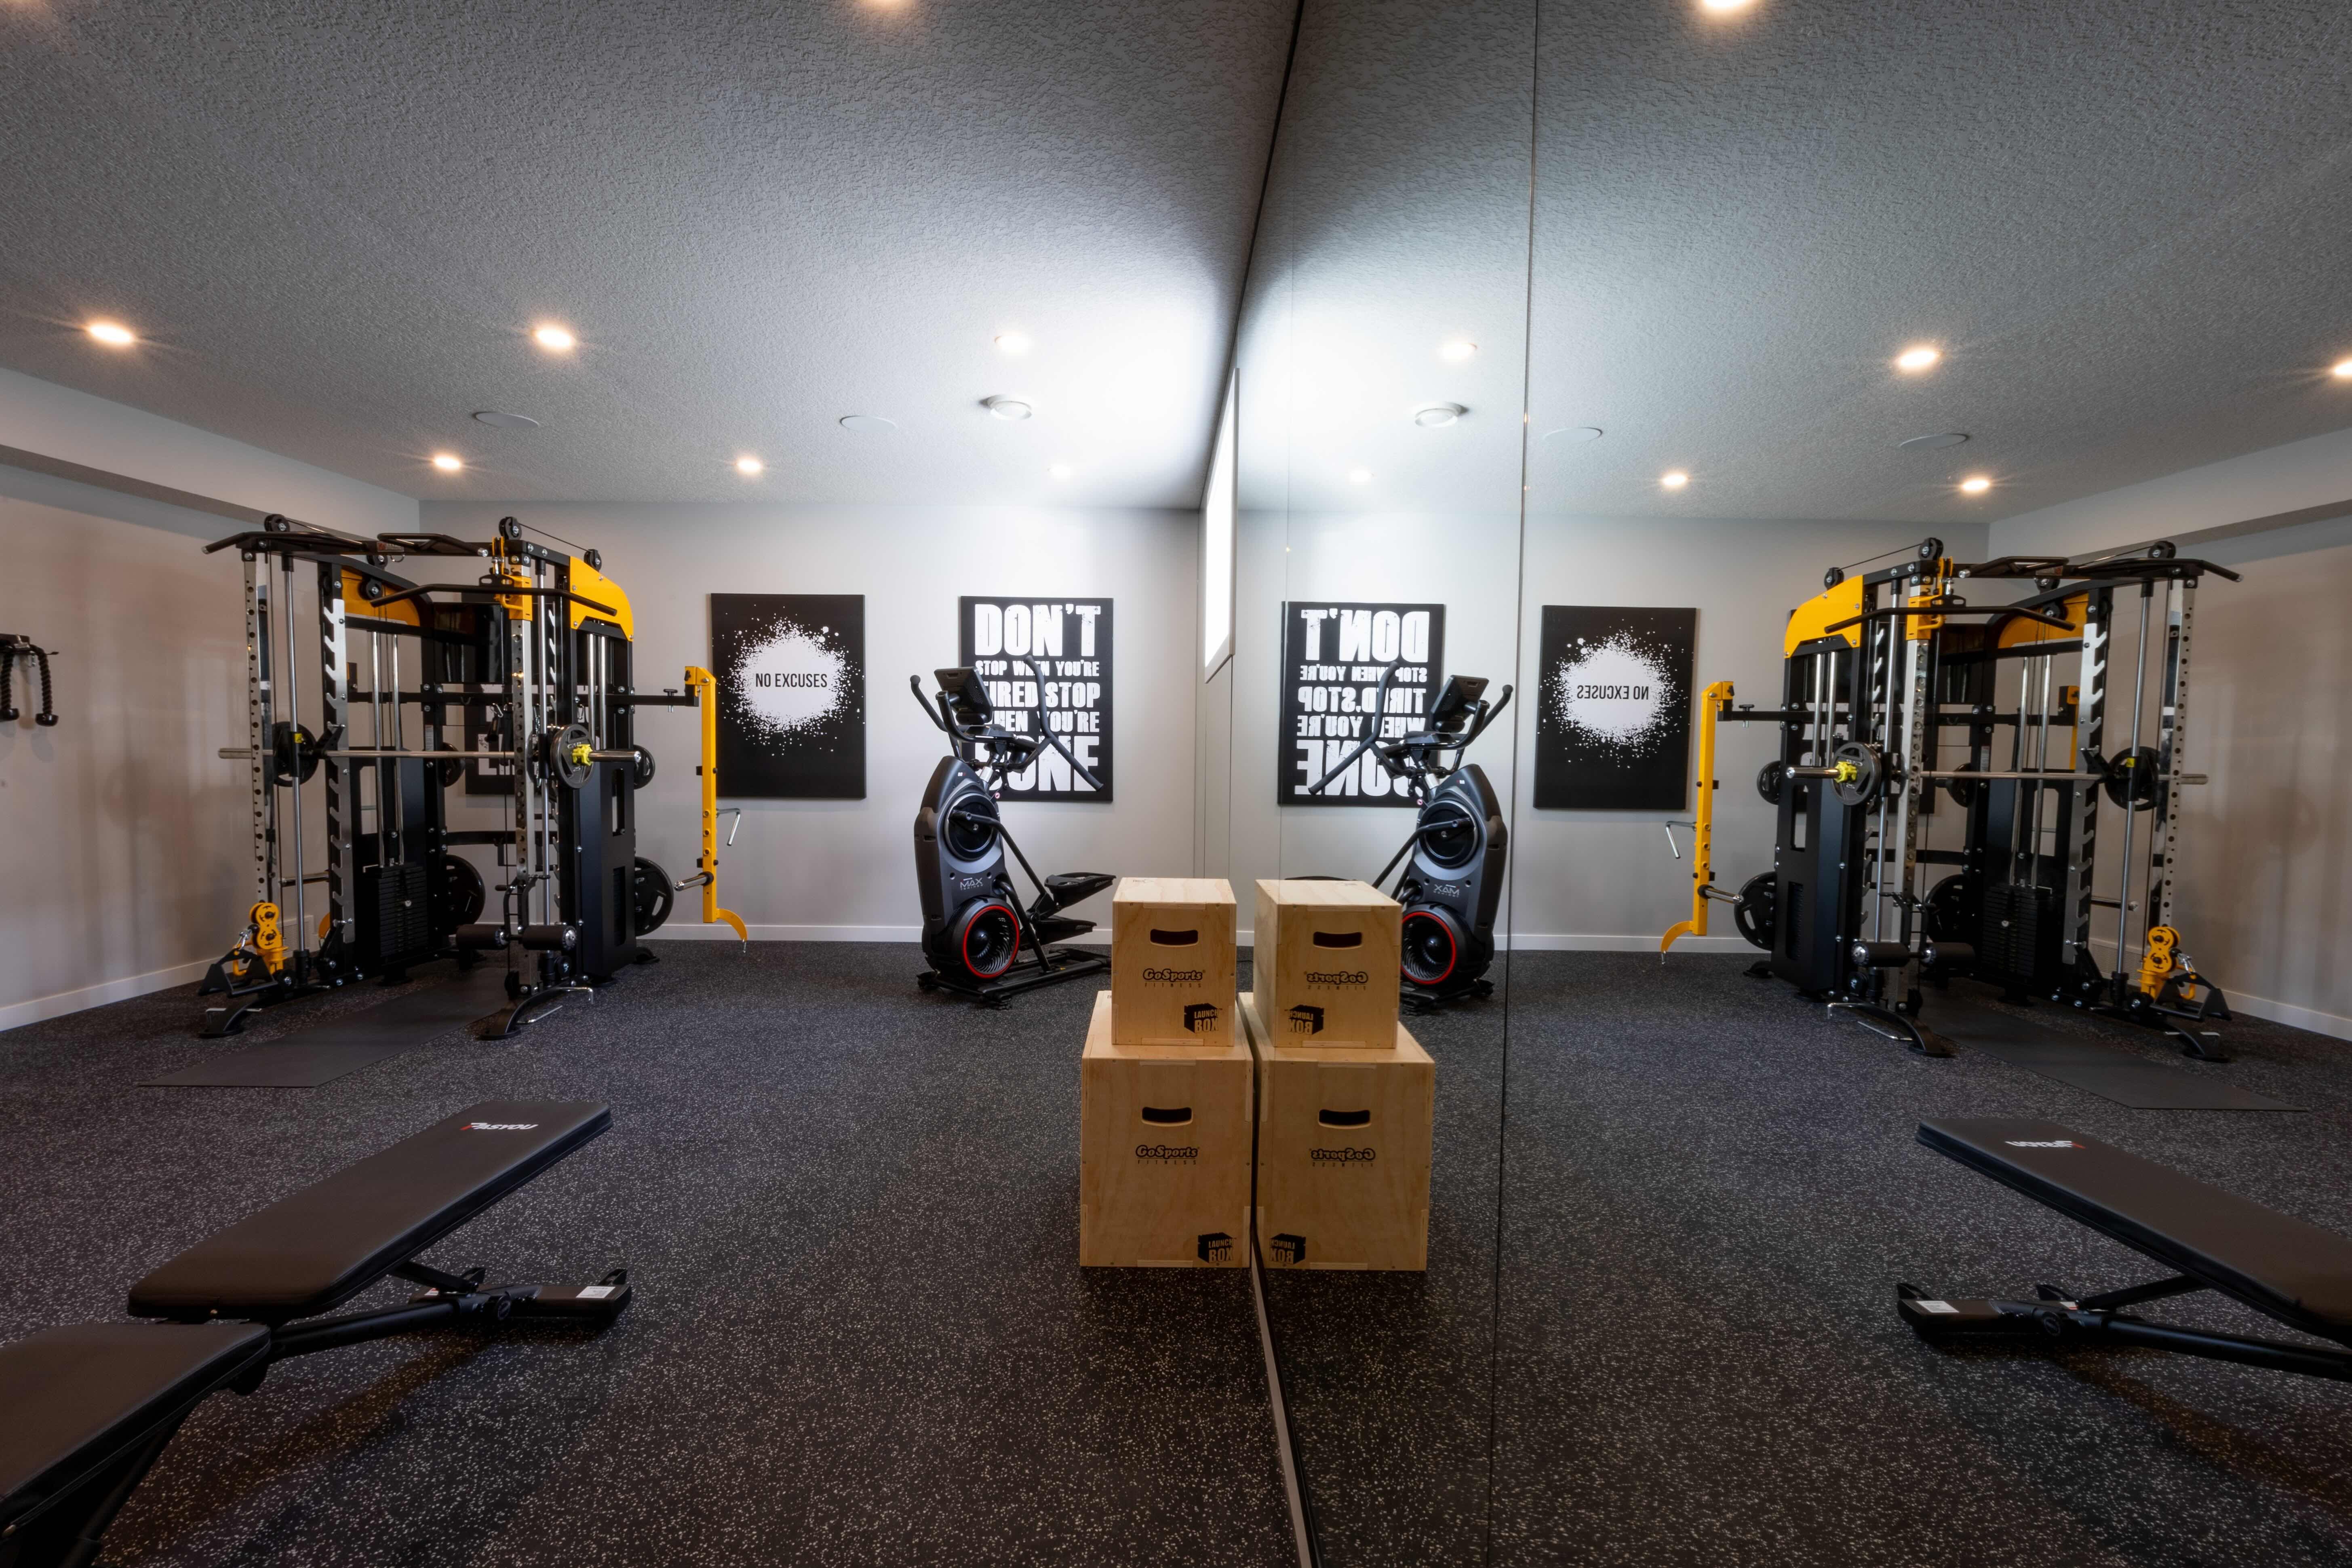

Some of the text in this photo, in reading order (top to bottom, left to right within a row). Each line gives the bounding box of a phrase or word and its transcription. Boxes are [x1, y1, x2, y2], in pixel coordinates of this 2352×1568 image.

[975, 604, 1101, 656] DON'T
[975, 660, 1099, 677] STOP WHN YOU'RE
[756, 673, 827, 687] NO EXCUSES
[983, 681, 1100, 708] IRED STOP
[984, 710, 1028, 732] HEN
[960, 877, 983, 888] MAX
[1143, 968, 1203, 982] GoSports
[1194, 1009, 1218, 1019] LAUNCH
[1195, 1018, 1219, 1033] BOX
[1136, 1144, 1198, 1159] GoSports
[1208, 1238, 1233, 1248] LAUNCH
[1209, 1248, 1233, 1263] BOX
